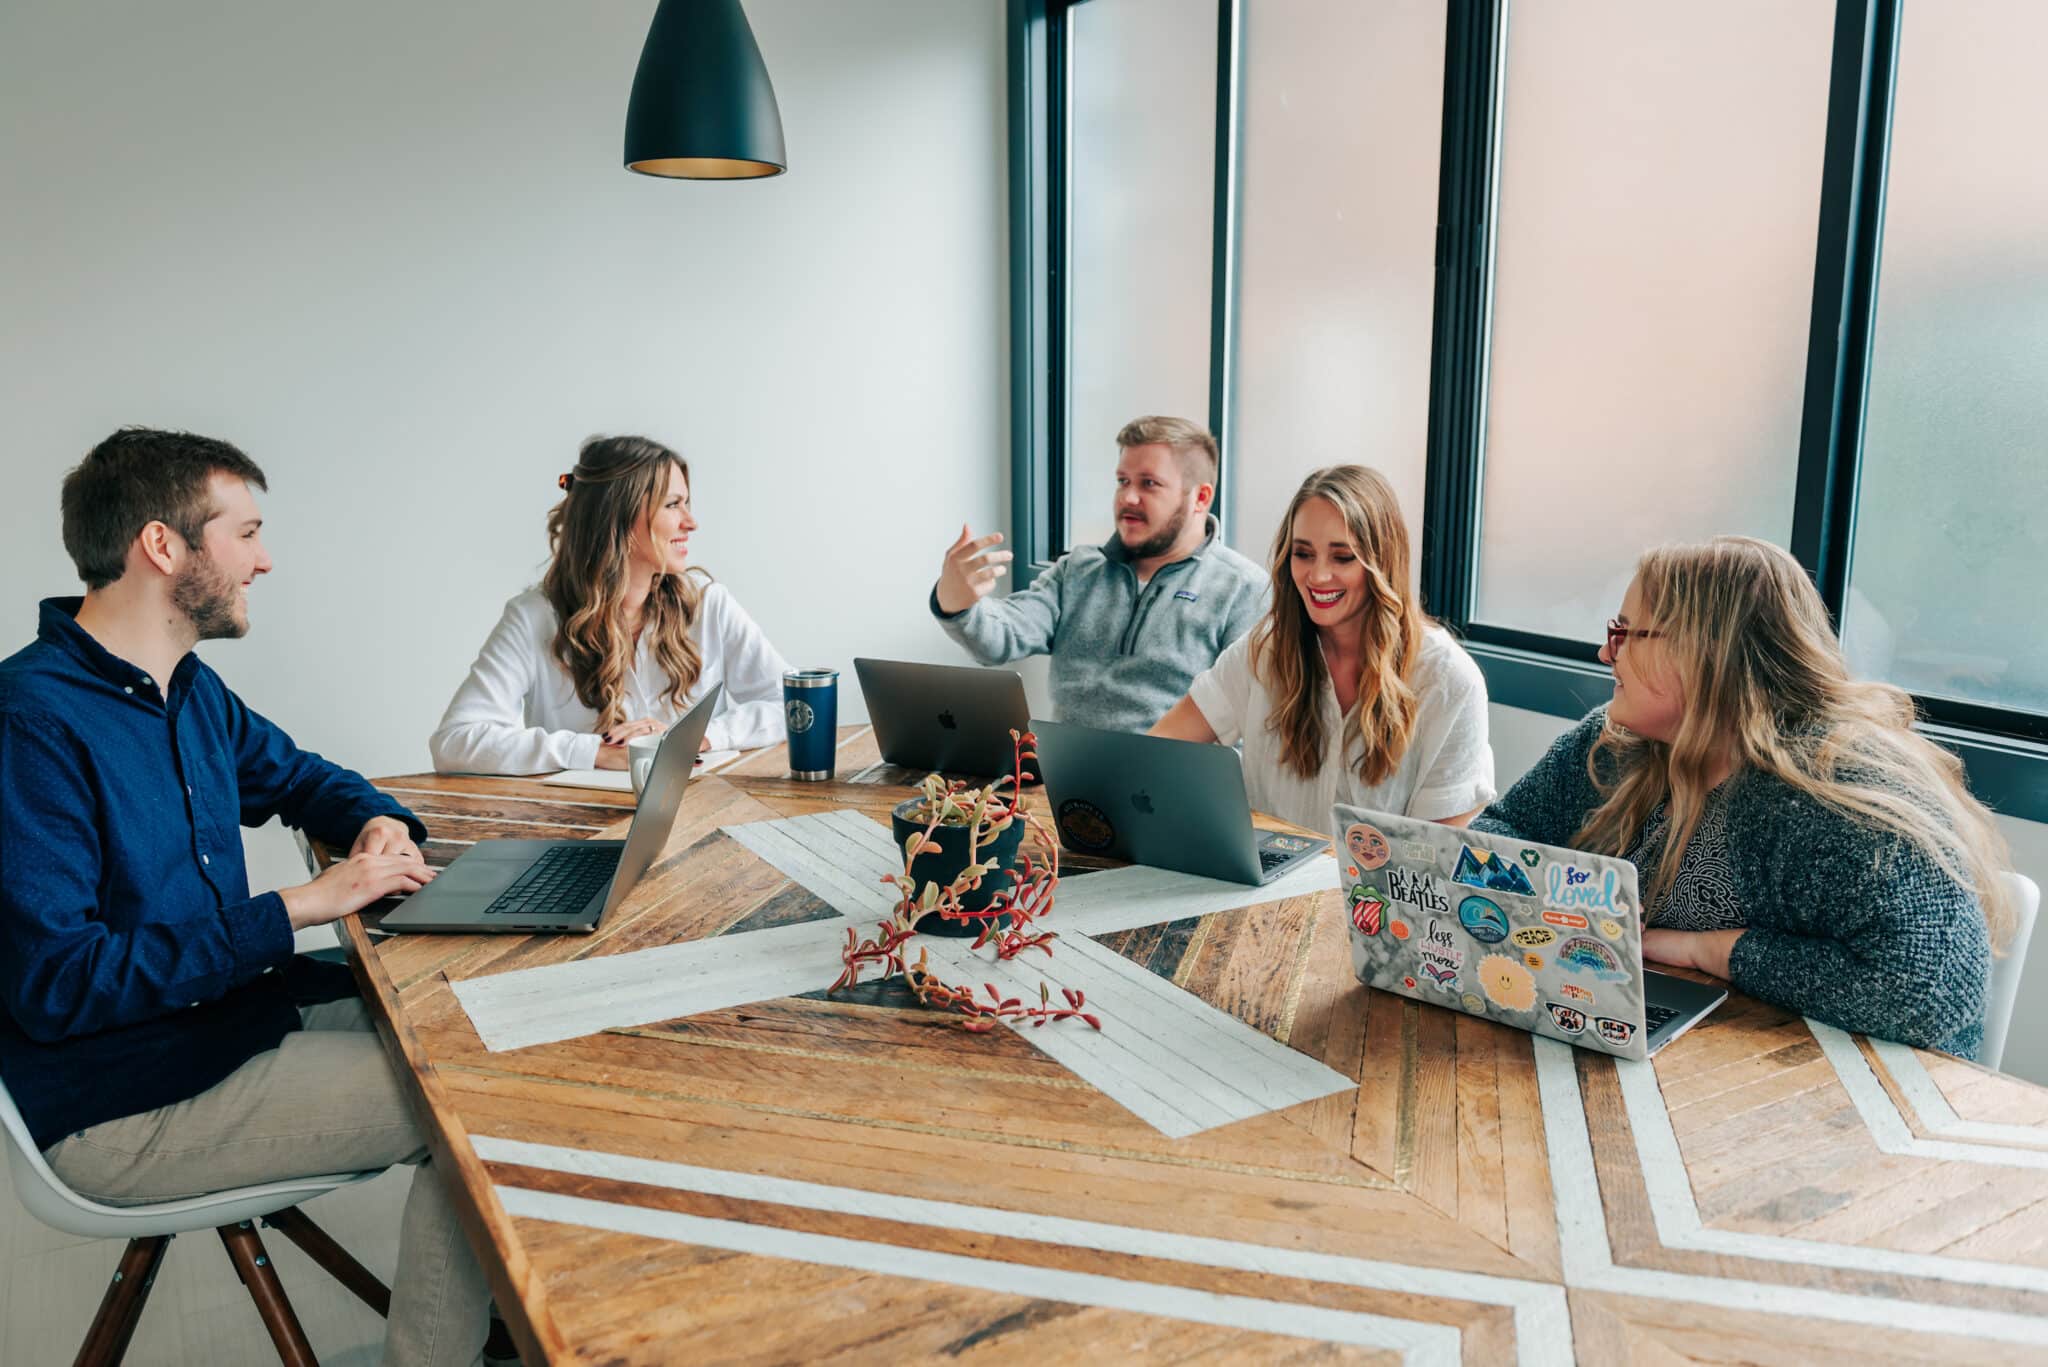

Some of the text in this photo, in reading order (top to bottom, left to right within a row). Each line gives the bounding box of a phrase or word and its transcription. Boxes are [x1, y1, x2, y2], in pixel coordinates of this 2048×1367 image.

[1388, 871, 1449, 912] BEATLES
[1549, 865, 1621, 914] loved
[1426, 919, 1454, 947] less
[1516, 930, 1552, 944] PEACE
[1421, 941, 1463, 963] HUSTLE
[1422, 951, 1459, 970] more
